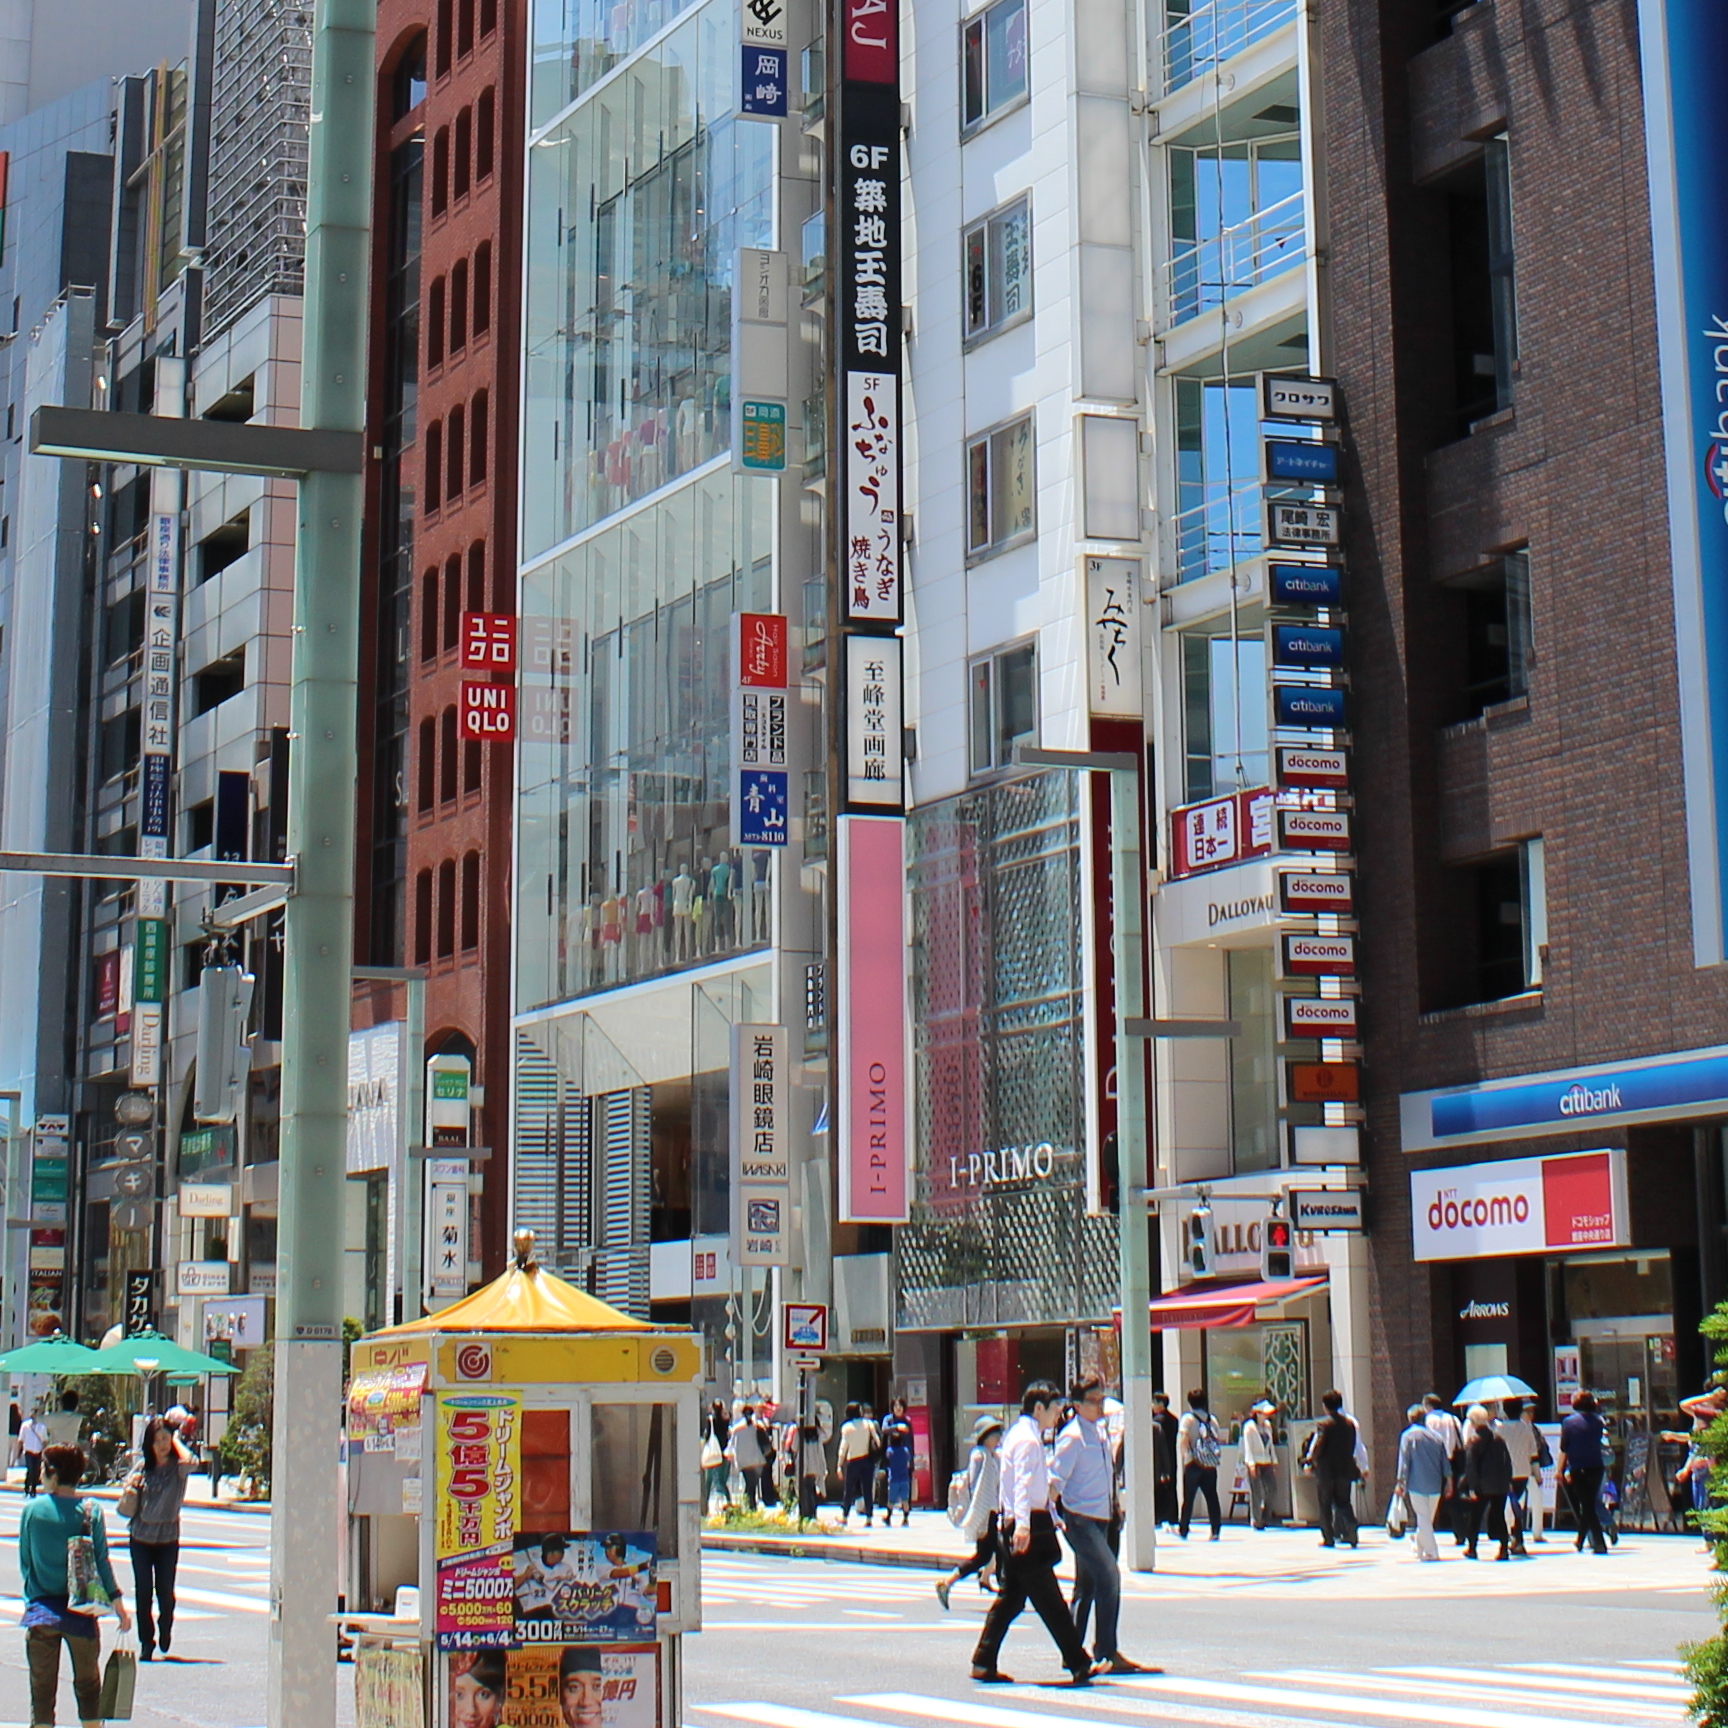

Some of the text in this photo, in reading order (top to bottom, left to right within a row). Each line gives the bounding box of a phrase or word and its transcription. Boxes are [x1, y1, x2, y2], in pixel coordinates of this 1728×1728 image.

[747, 26, 783, 40] NEXUS
[849, 143, 889, 170] 6F
[863, 377, 881, 391] 5F
[1273, 390, 1329, 406] クロサワ
[1276, 455, 1331, 469] アートネイチャー
[1281, 509, 1330, 528] 尾崎 宏
[1281, 527, 1331, 541] 法律事務所
[849, 534, 872, 610] 焼き鳥
[875, 526, 895, 602] うなぎ
[1089, 559, 1103, 572] 3F
[1285, 577, 1330, 593] citibank
[469, 617, 511, 638] ユニ
[468, 641, 511, 663] クロ
[1288, 637, 1332, 653] citibank
[147, 627, 172, 746] 企画通信社
[741, 675, 752, 685] 4F
[467, 686, 506, 709] UNI
[1290, 697, 1334, 713] citibank
[467, 711, 510, 734] QLO
[743, 694, 758, 763] 買取専門店
[770, 695, 785, 764] ブランド品
[861, 660, 886, 783] 至峰堂画廊
[1287, 752, 1340, 771] docomo
[743, 783, 784, 827] 青山
[1193, 806, 1229, 836] 連続
[1288, 815, 1342, 832] docomo
[1194, 835, 1230, 862] 日本一
[1291, 878, 1345, 895] docomo
[1293, 941, 1347, 958] docomo
[1296, 1004, 1349, 1020] docomo
[137, 1010, 161, 1077] Darling
[436, 1087, 466, 1098] セリナ
[752, 1034, 775, 1154] 岩崎眼鏡店
[1559, 1082, 1622, 1117] citibank
[869, 1061, 887, 1195] I-PRIMO
[742, 1161, 786, 1177] IWASAKI
[948, 1141, 1054, 1188] I-PRIMO
[124, 1136, 144, 1227] マギー
[189, 1191, 225, 1206] Darling
[1443, 1188, 1458, 1198] NTT
[445, 1192, 457, 1218] 銀座
[1300, 1202, 1358, 1218] KUROSAWA
[1427, 1189, 1529, 1231] docomo
[1571, 1213, 1610, 1228] ドコモショップ
[441, 1224, 459, 1269] 菊水
[129, 1276, 150, 1332] タカゲ
[447, 1410, 492, 1548] 5億5千万円
[493, 1409, 514, 1541] ドリームジャンボ
[558, 1598, 616, 1613] スクラッチ
[515, 1619, 563, 1641] 300万円
